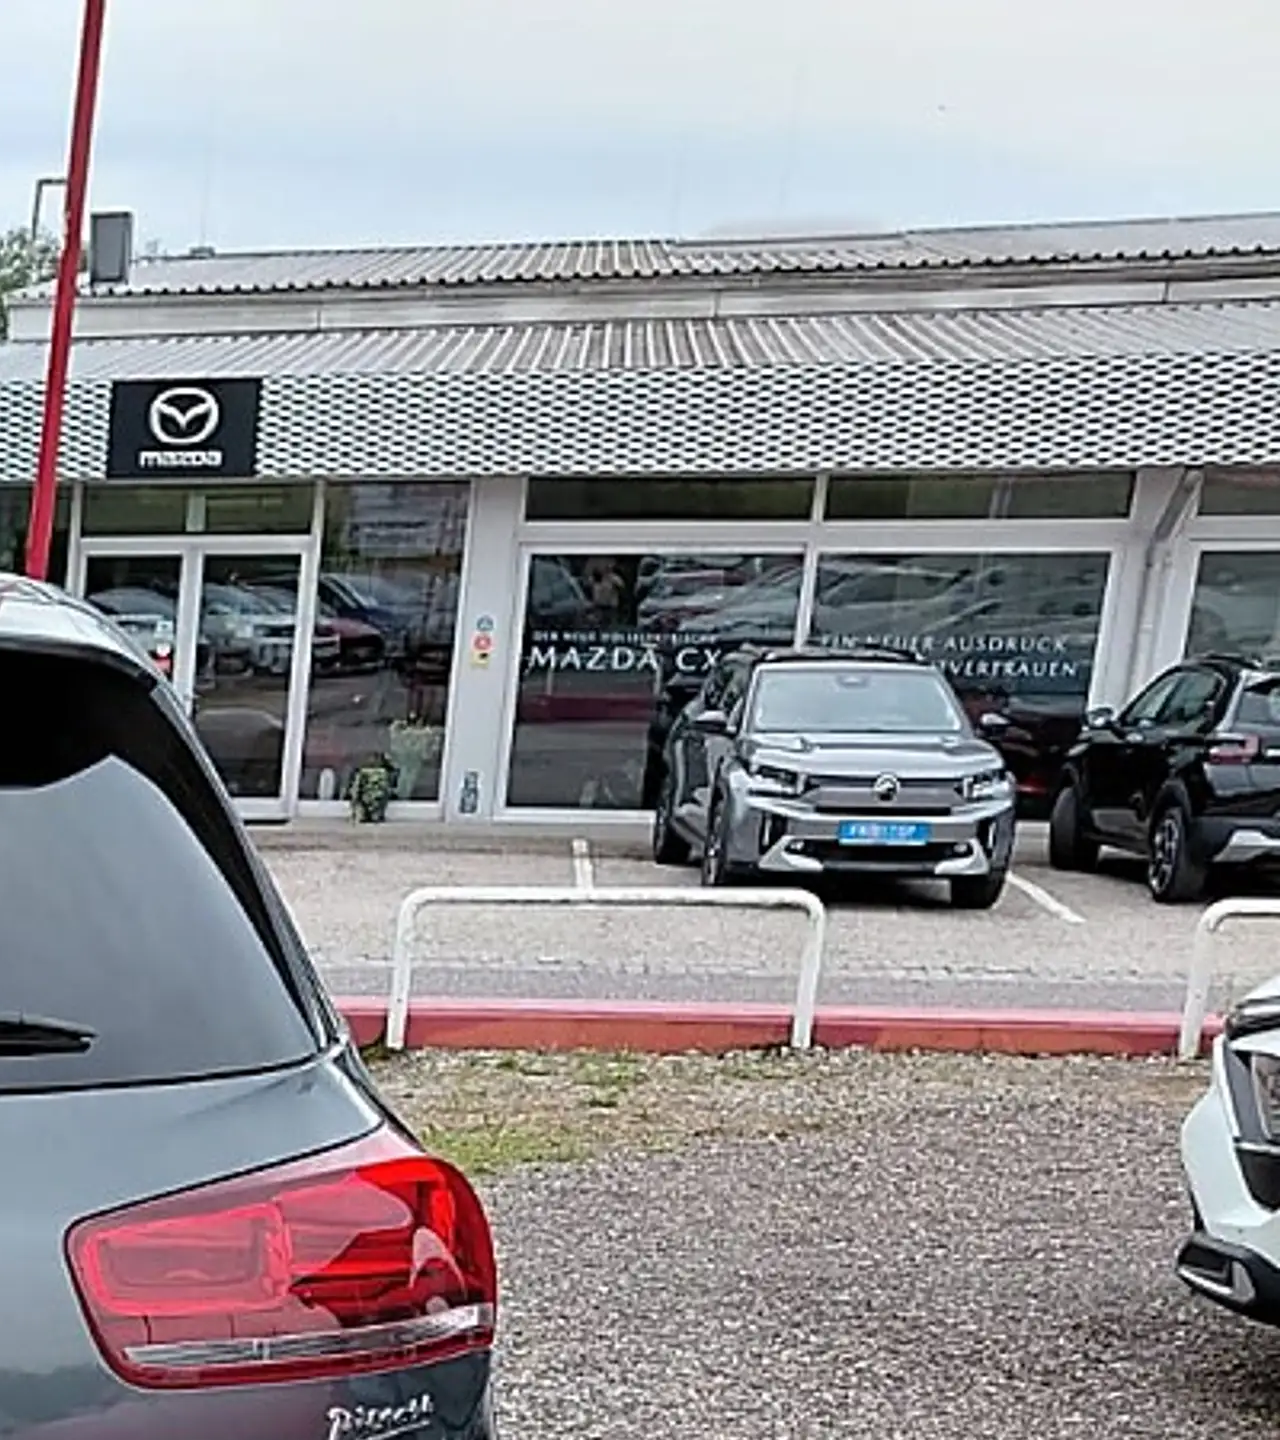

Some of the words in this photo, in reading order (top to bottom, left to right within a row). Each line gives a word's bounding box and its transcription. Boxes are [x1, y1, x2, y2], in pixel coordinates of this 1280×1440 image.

[139, 450, 223, 468] mazda
[943, 635, 1070, 652] AUSDRUCK
[528, 646, 659, 672] MAZDA
